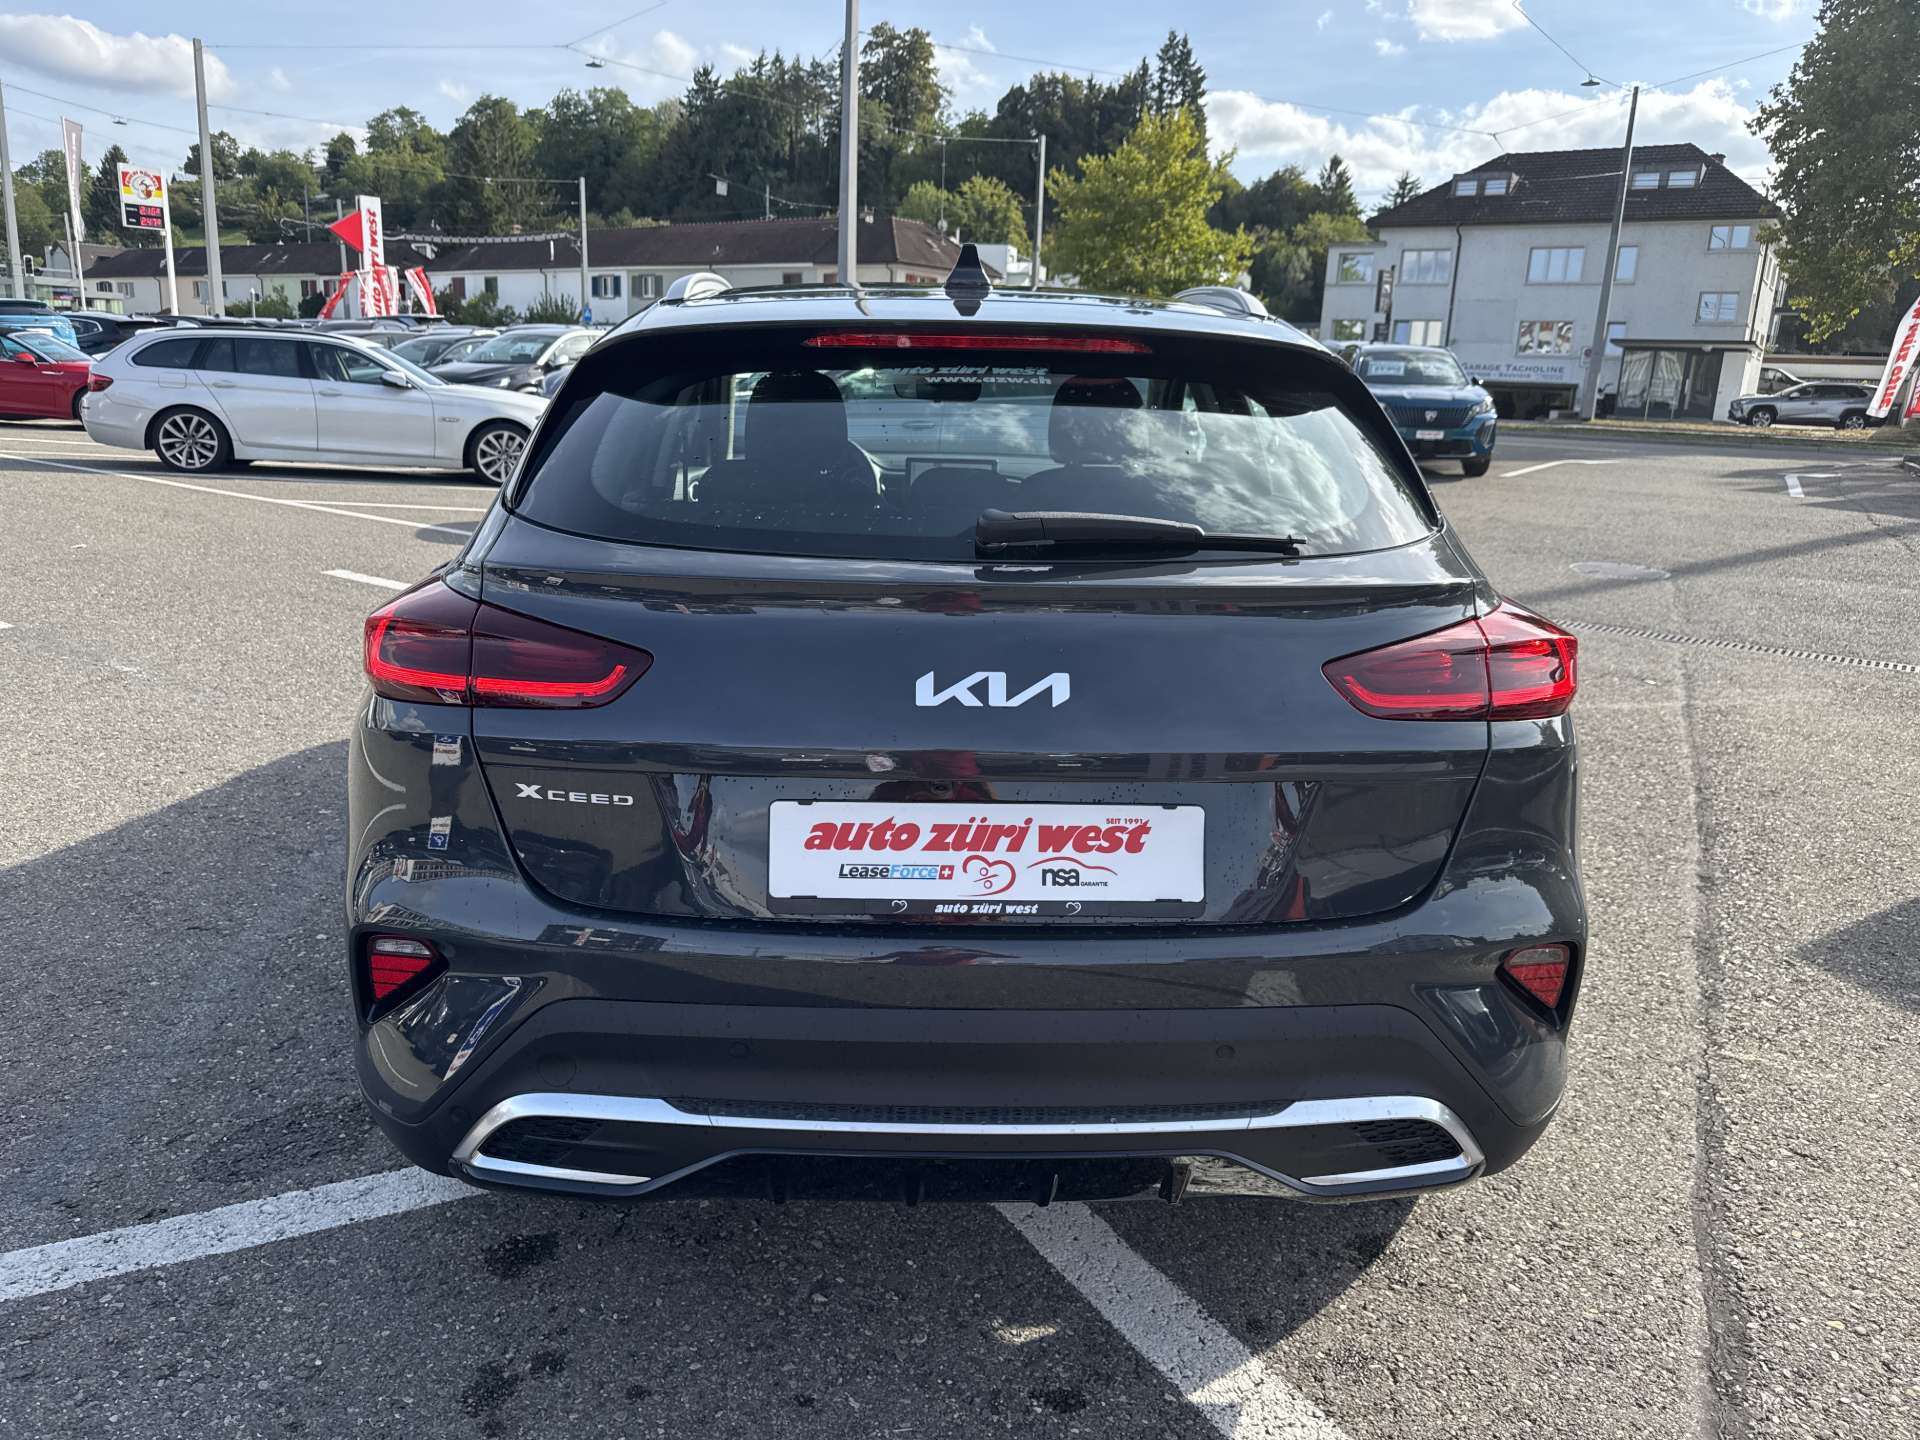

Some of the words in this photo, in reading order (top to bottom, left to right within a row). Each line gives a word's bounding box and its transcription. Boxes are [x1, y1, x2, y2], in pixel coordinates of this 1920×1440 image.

[367, 208, 378, 248] west
[1506, 363, 1566, 374] TACHOLINE
[925, 376, 1052, 385] www.azw.ch
[1105, 817, 1122, 825] SEIT
[1124, 817, 1144, 825] 1991
[803, 815, 921, 852] auto
[921, 816, 1035, 853] züri
[1037, 819, 1153, 854] west
[838, 864, 939, 880] LeaseForce
[1041, 867, 1080, 887] nsa
[934, 903, 969, 914] auto
[970, 902, 1003, 914] züri
[1004, 903, 1039, 915] west
